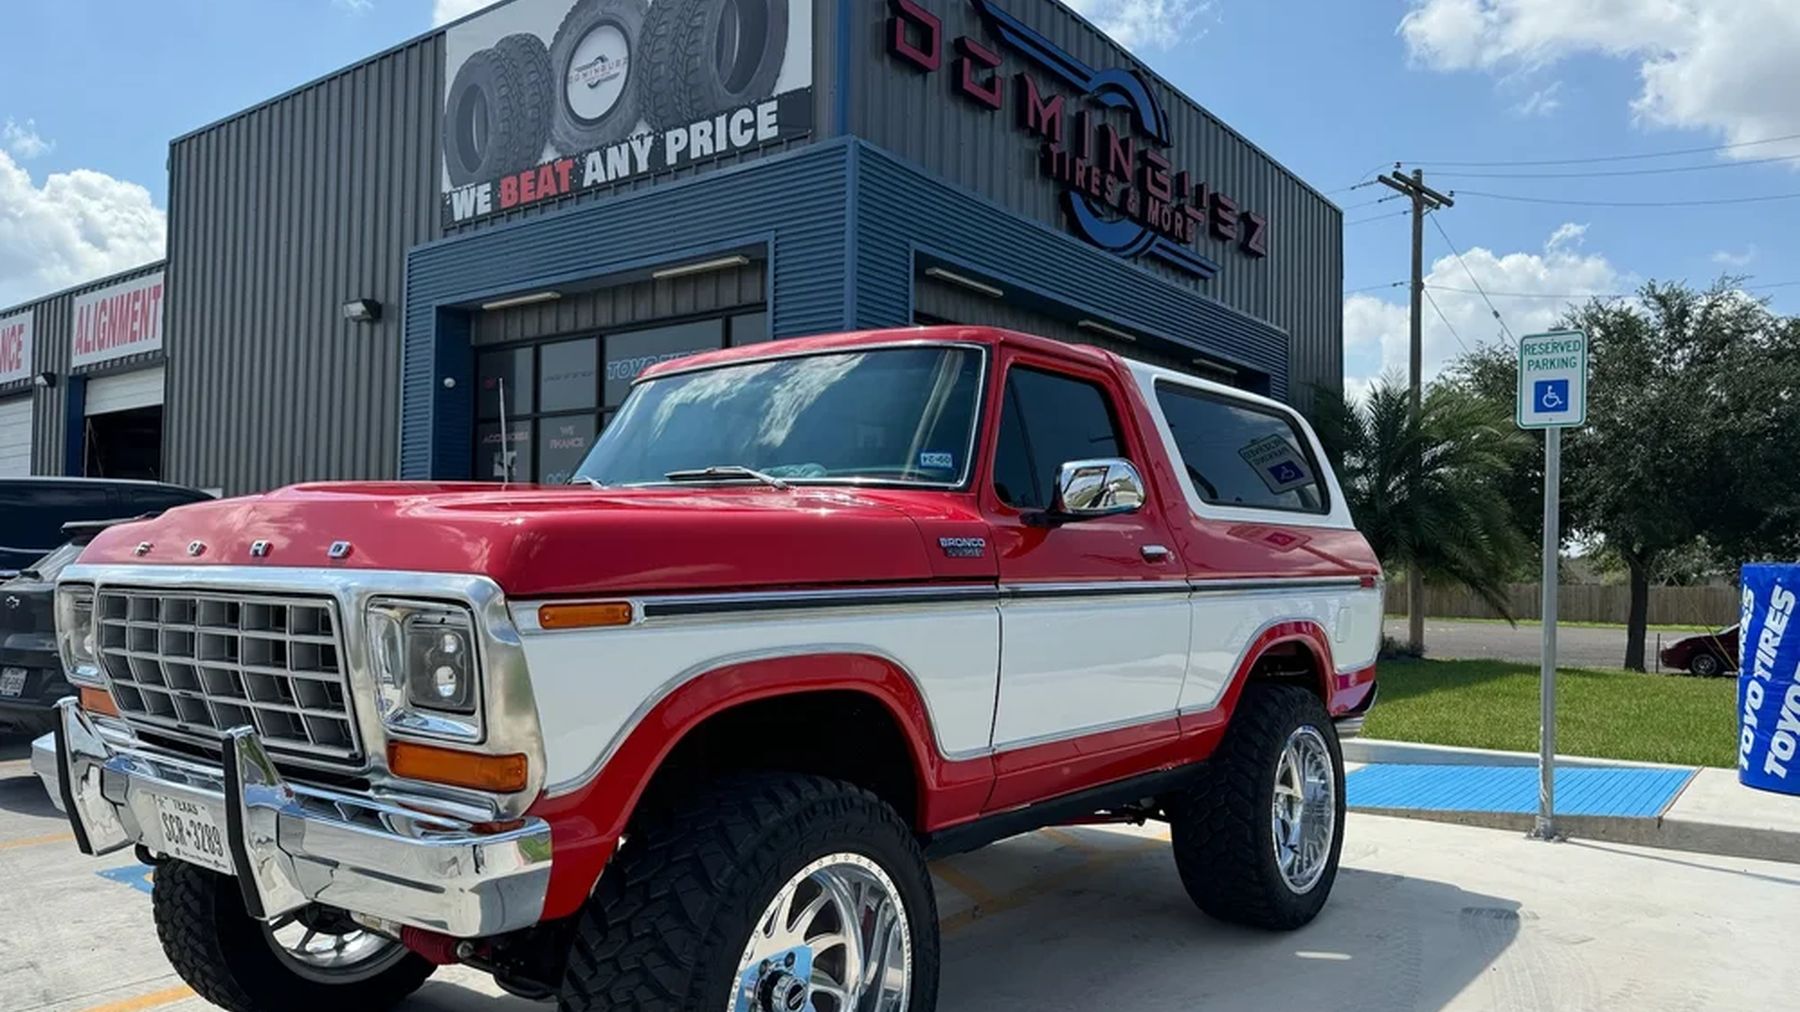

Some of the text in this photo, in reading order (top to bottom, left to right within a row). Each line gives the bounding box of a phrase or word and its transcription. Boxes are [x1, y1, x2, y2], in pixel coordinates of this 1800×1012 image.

[451, 100, 779, 222] WE BEAT ANY PRICE
[1043, 142, 1115, 200] TIRES
[1146, 199, 1196, 243] MORE
[75, 284, 162, 354] ALIGNMENT
[1524, 340, 1580, 356] RESERVED
[1527, 356, 1577, 371] PARKING
[939, 537, 985, 548] BRONCO
[1753, 585, 1796, 681] TIRES
